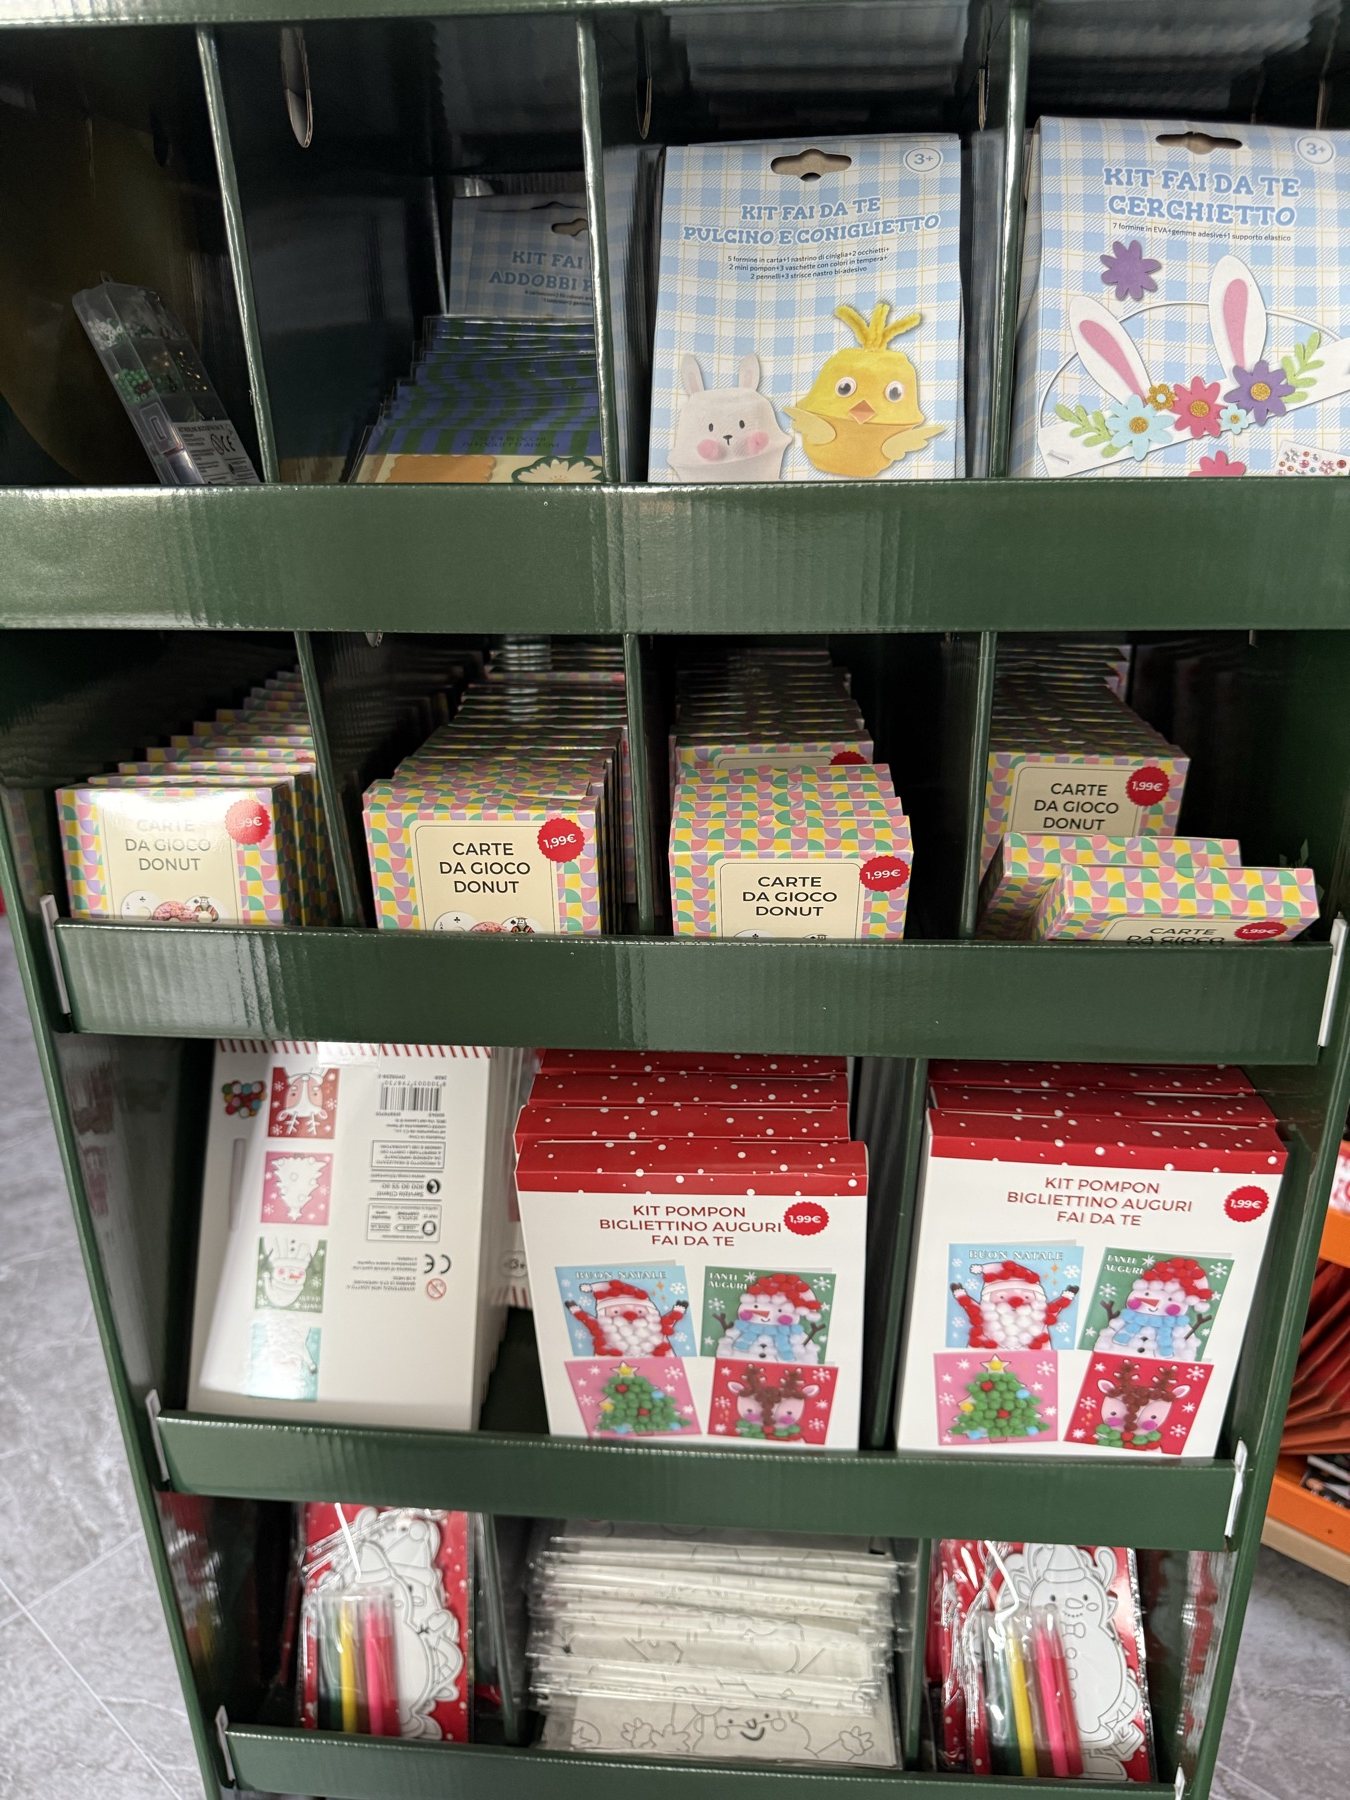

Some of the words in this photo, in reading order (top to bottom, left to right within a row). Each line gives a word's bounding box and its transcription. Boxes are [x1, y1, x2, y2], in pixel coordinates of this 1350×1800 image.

[1306, 143, 1326, 155] 3+
[913, 153, 934, 165] 3+
[1104, 168, 1155, 187] KIT
[1162, 170, 1207, 191] FAI
[1214, 174, 1254, 195] DA
[1260, 176, 1300, 197] TE
[741, 205, 778, 221] KIT
[782, 205, 815, 220] FAI
[820, 200, 848, 218] DA
[852, 197, 881, 213] TE
[1108, 196, 1296, 226] CERCHIETTO
[683, 226, 774, 245] PULCINO
[779, 227, 793, 244] E
[796, 215, 940, 243] CONIGLIETTO
[1118, 223, 1145, 232] formine
[1232, 233, 1263, 242] supporto
[1264, 234, 1291, 242] elastico
[512, 251, 546, 265] KIT
[551, 253, 584, 269] FAI
[733, 256, 757, 264] formine
[791, 255, 817, 263] nastrino
[785, 263, 816, 271] vaschette
[790, 271, 812, 279] strisce
[812, 269, 833, 277] nastro
[834, 266, 867, 275] bi-adesivo
[489, 271, 576, 291] ADDOBBI
[1050, 783, 1108, 797] CARTE
[1131, 780, 1163, 793] 1,99€
[1033, 799, 1058, 811] DA
[1063, 800, 1119, 814] GIOCO
[137, 819, 195, 832] CARTE
[1042, 816, 1105, 831] DONUT
[125, 838, 150, 851] DA
[154, 838, 211, 852] GIOCO
[543, 833, 577, 850] 1,99€
[452, 842, 514, 856] CARTE
[139, 858, 201, 871] DONUT
[439, 861, 466, 875] DA
[470, 861, 531, 875] GIOCO
[865, 868, 901, 881] 1,99€
[454, 880, 519, 894] DONUT
[758, 876, 822, 888] CARTE
[742, 891, 769, 902] DA
[774, 891, 837, 902] GIOCO
[755, 906, 824, 916] DONUT
[1150, 927, 1217, 936] CARTE
[1045, 1176, 1074, 1190] KIT
[1078, 1179, 1160, 1194] POMPON
[1007, 1191, 1118, 1209] BIGLIETTINO
[1121, 1198, 1192, 1212] AUGURI
[1230, 1199, 1262, 1211] 1,99€
[633, 1205, 661, 1216] KIT
[666, 1206, 746, 1218] POMPON
[789, 1214, 821, 1225] 1,99€
[1057, 1211, 1085, 1223] FAI
[1090, 1212, 1116, 1225] DA
[1120, 1214, 1142, 1226] TE
[599, 1218, 708, 1232] BIGLIETTINO
[712, 1221, 782, 1233] AUGURI
[651, 1234, 679, 1246] FAI
[684, 1235, 708, 1246] DA
[713, 1236, 735, 1247] TE
[968, 1250, 1008, 1260] BUON
[1013, 1250, 1063, 1261] NATALE
[575, 1270, 615, 1280] BUON
[620, 1270, 667, 1280] NATALE
